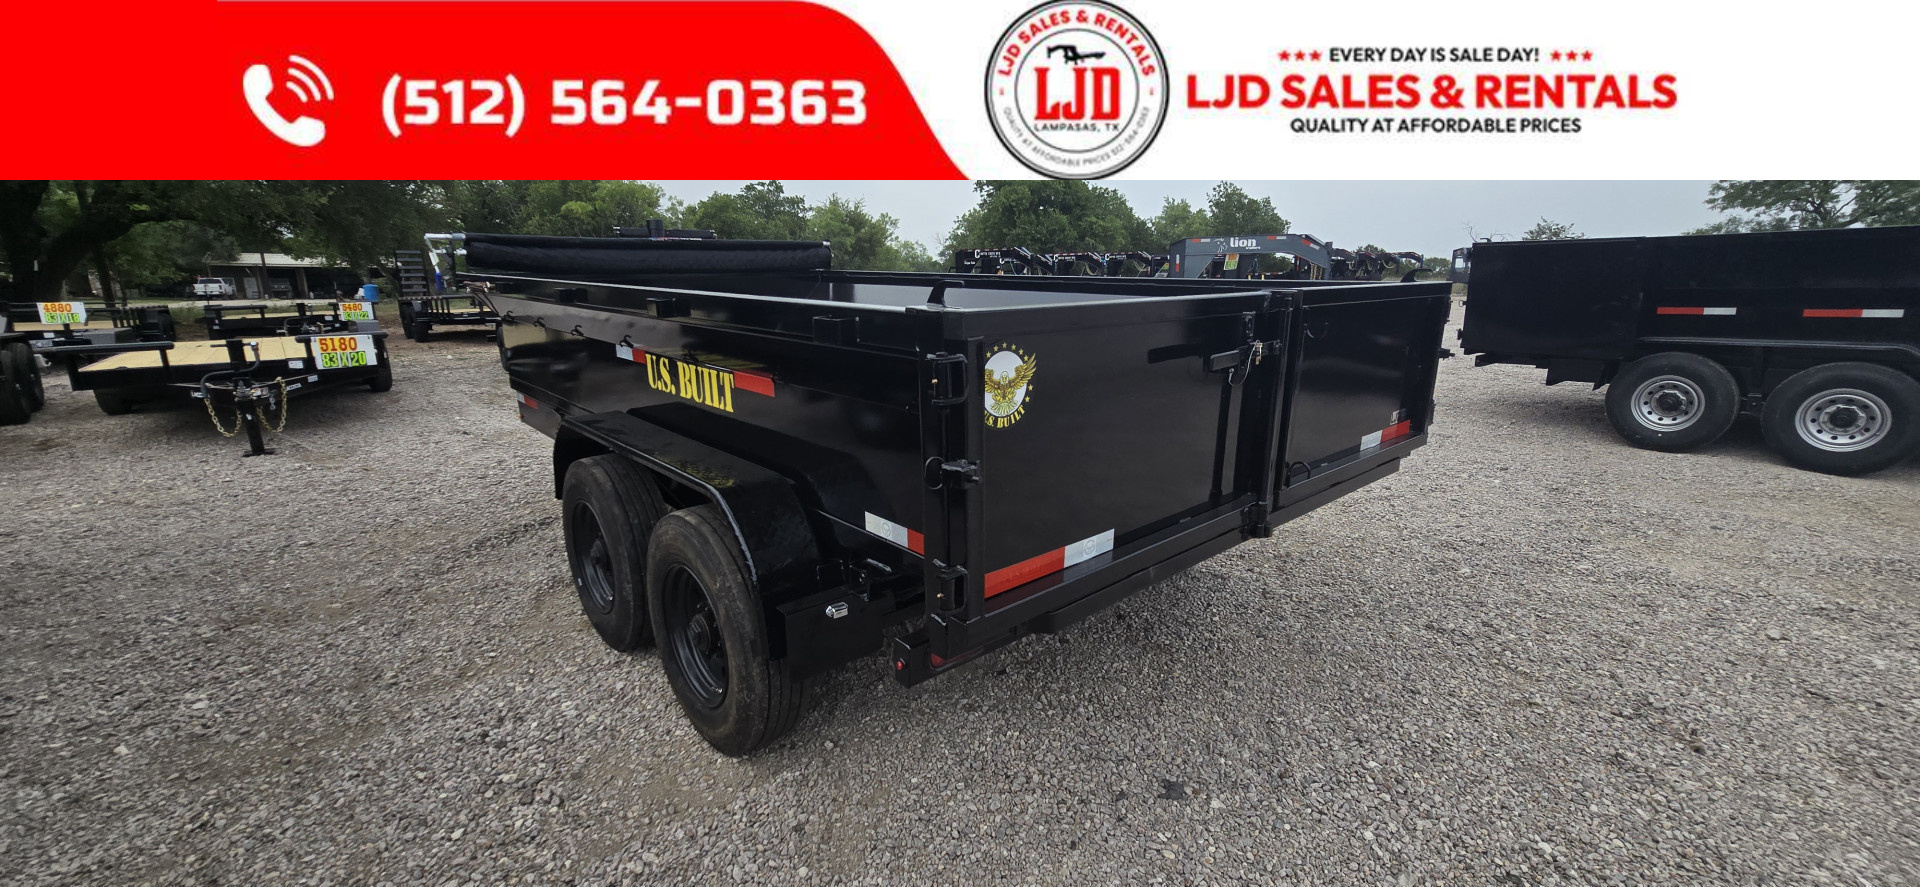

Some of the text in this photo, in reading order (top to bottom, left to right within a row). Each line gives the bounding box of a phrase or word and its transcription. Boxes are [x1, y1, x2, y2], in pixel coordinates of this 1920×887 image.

[1230, 237, 1257, 248] lion
[43, 303, 72, 313] 4880
[68, 312, 80, 323] 18
[319, 337, 358, 352] 5180
[322, 351, 367, 368] 83 X 20
[645, 353, 735, 413] U.S. BUILT
[997, 405, 1025, 429] BUILT
